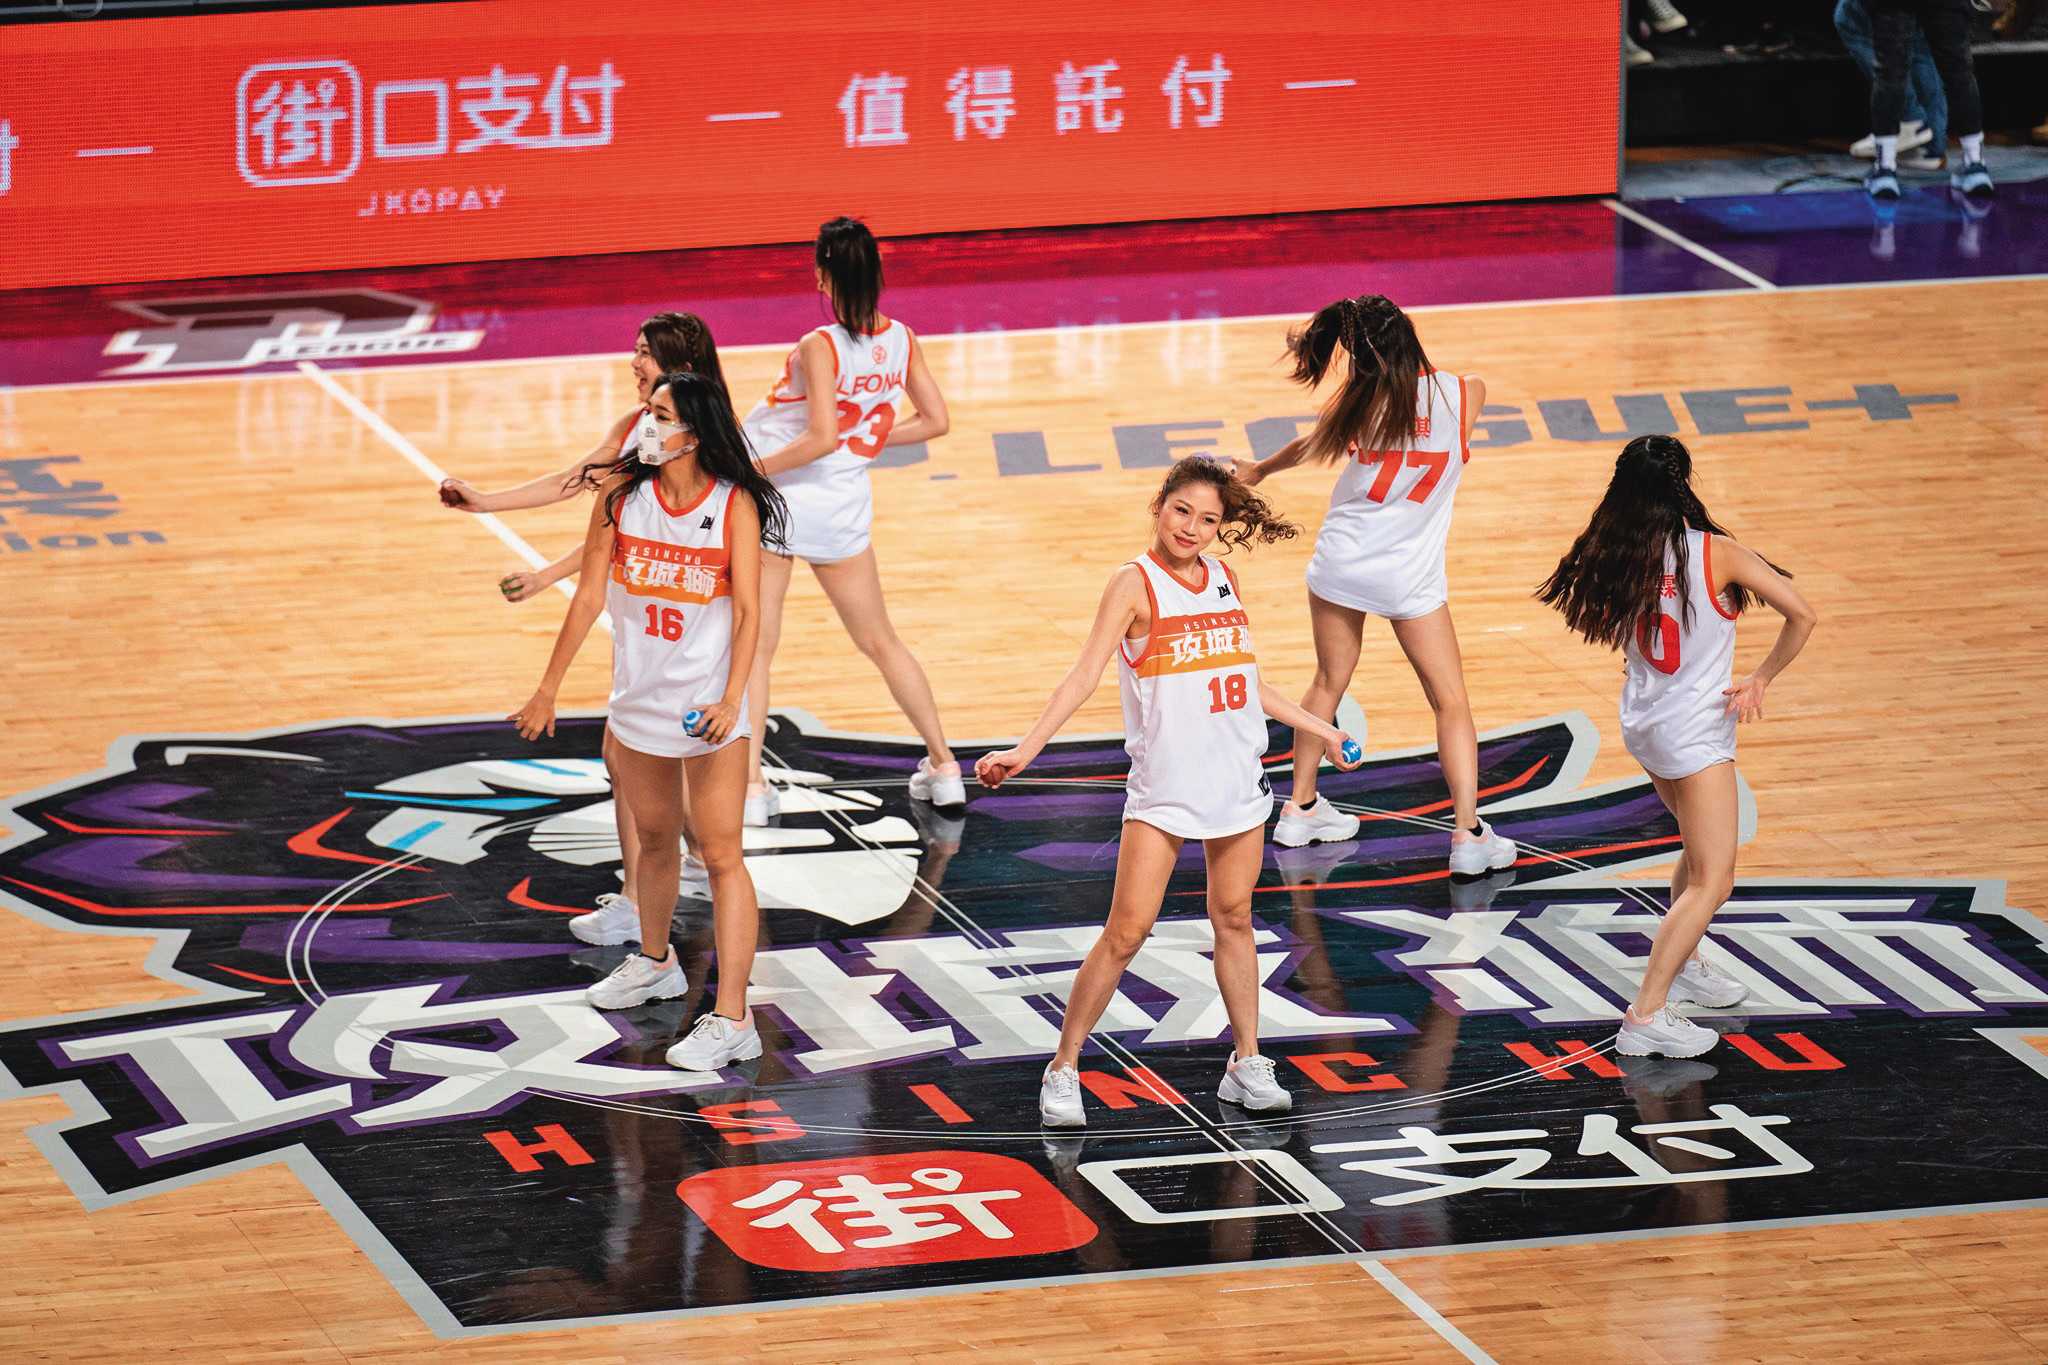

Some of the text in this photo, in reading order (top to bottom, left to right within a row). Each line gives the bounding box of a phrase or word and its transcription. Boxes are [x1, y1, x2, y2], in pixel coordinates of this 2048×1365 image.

[250, 62, 624, 169] 街口支付
[837, 53, 1232, 148] 值得託付
[357, 184, 507, 216] JKOPAY
[837, 369, 906, 396] LEONA
[1357, 449, 1450, 504] 77
[0, 531, 166, 552] ion
[629, 546, 701, 566] HSINCHU
[645, 604, 684, 642] 16
[1208, 673, 1247, 714] 18
[484, 1032, 1847, 1173] HSINCHU
[732, 1103, 1813, 1255] 街口支付
